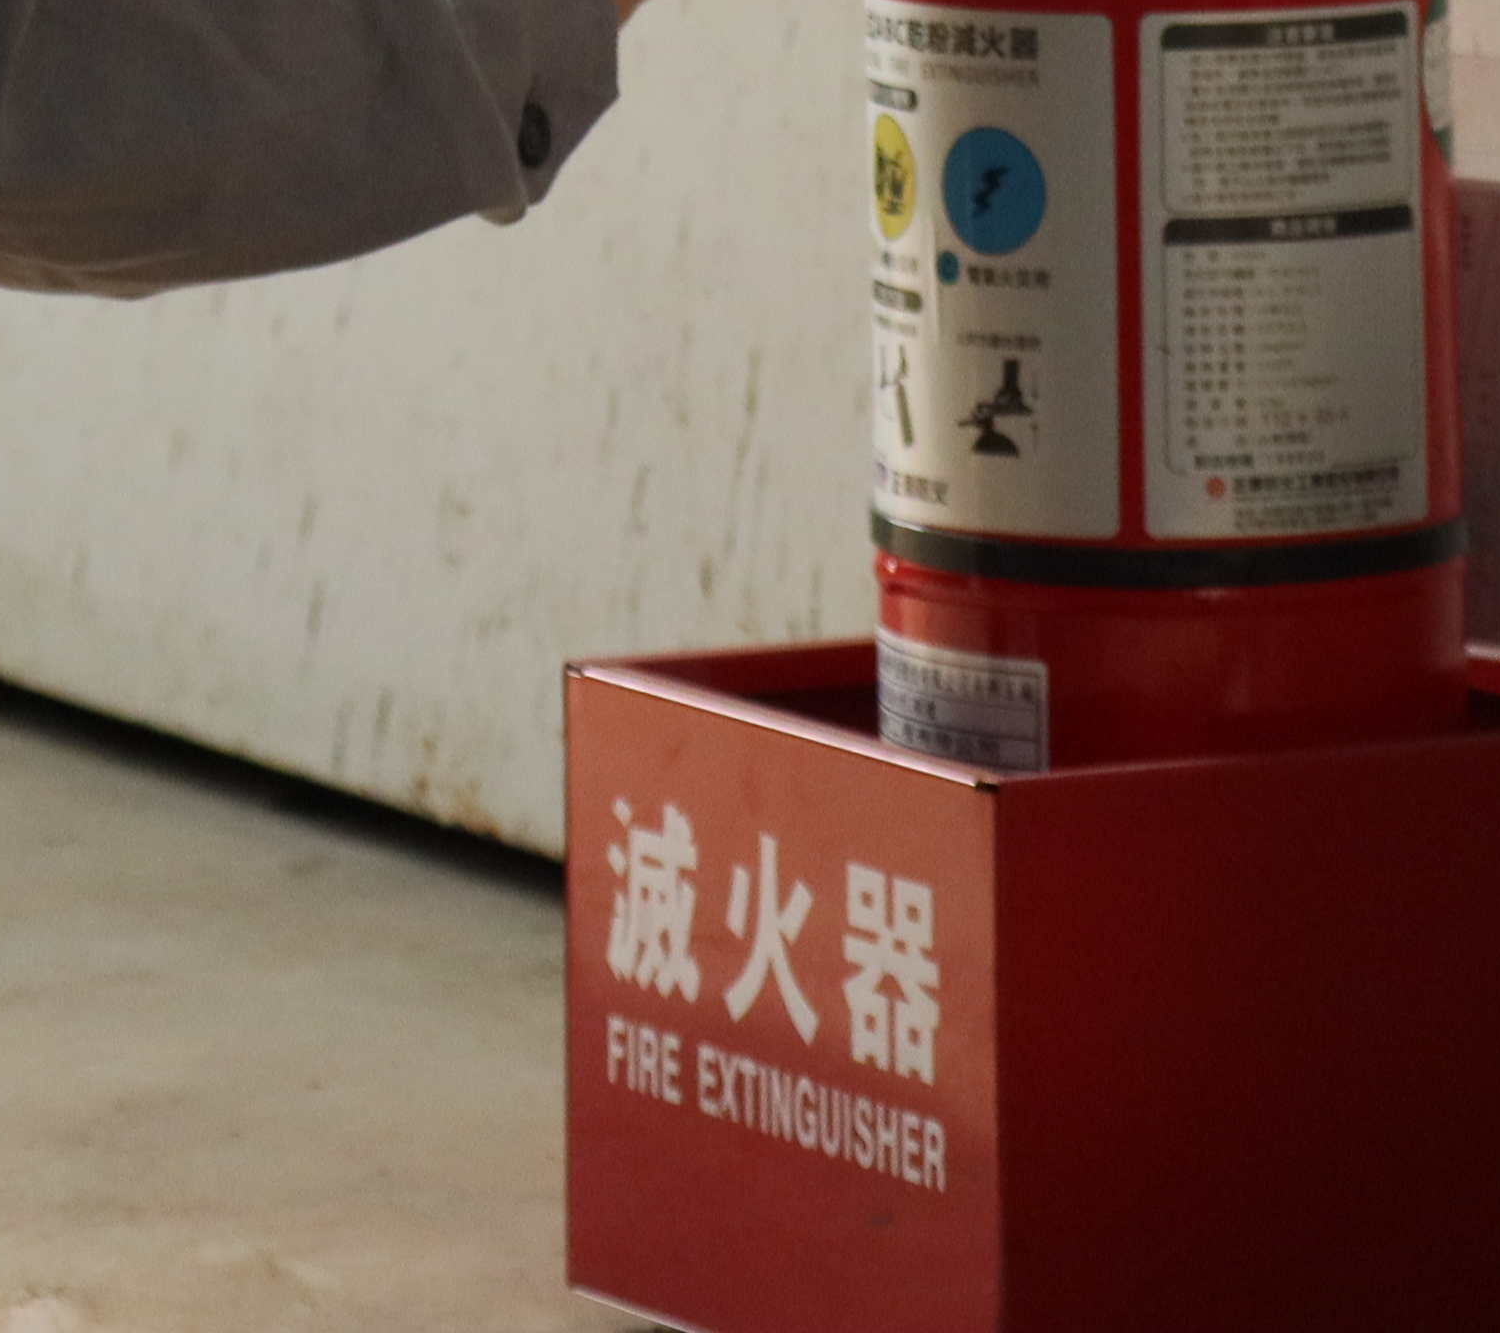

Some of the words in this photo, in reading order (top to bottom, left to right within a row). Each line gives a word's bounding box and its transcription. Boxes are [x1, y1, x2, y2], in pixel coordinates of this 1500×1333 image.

[607, 797, 942, 1086] 滅火器
[606, 1015, 682, 1105] FIRE
[698, 1045, 948, 1194] EXTINGUISHER
